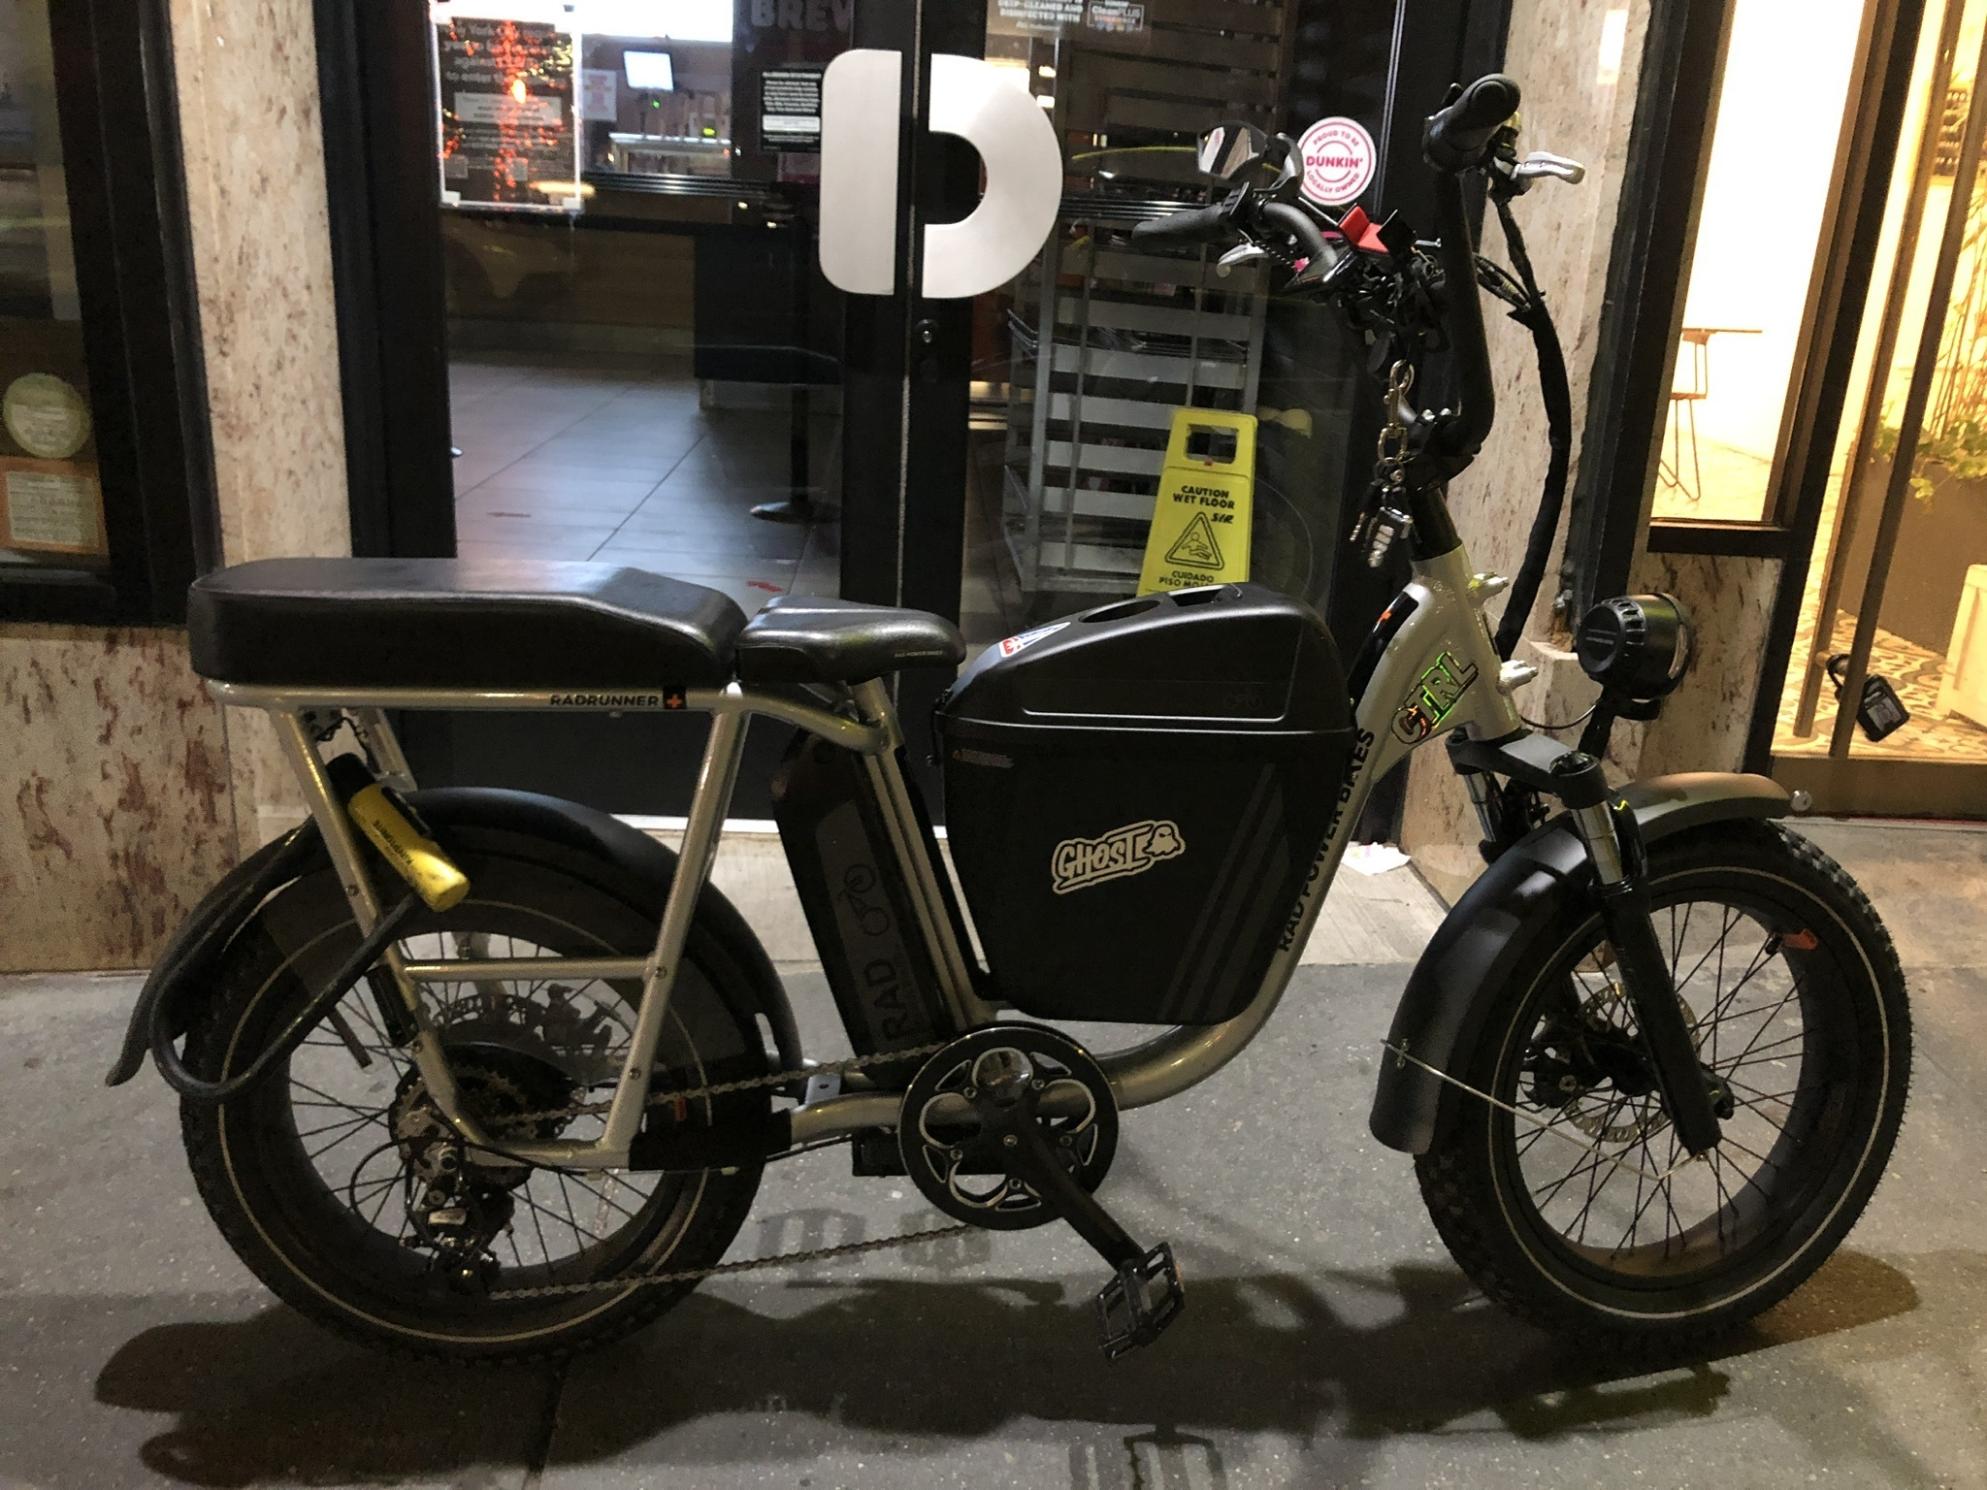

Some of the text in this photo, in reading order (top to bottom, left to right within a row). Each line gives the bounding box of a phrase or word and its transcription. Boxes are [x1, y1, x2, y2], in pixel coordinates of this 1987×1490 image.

[1313, 130, 1360, 146] PROUD TO BE
[1306, 155, 1363, 168] DUNKIN'
[1306, 170, 1360, 193] LOCALLY OWNED
[1181, 485, 1229, 498] CAUTION
[1173, 493, 1235, 509] WET FLOOR
[1159, 576, 1181, 586] PISO
[1172, 570, 1214, 583] CUIDADO
[550, 694, 660, 706] RADRUNNER
[863, 958, 908, 1041] RAD
